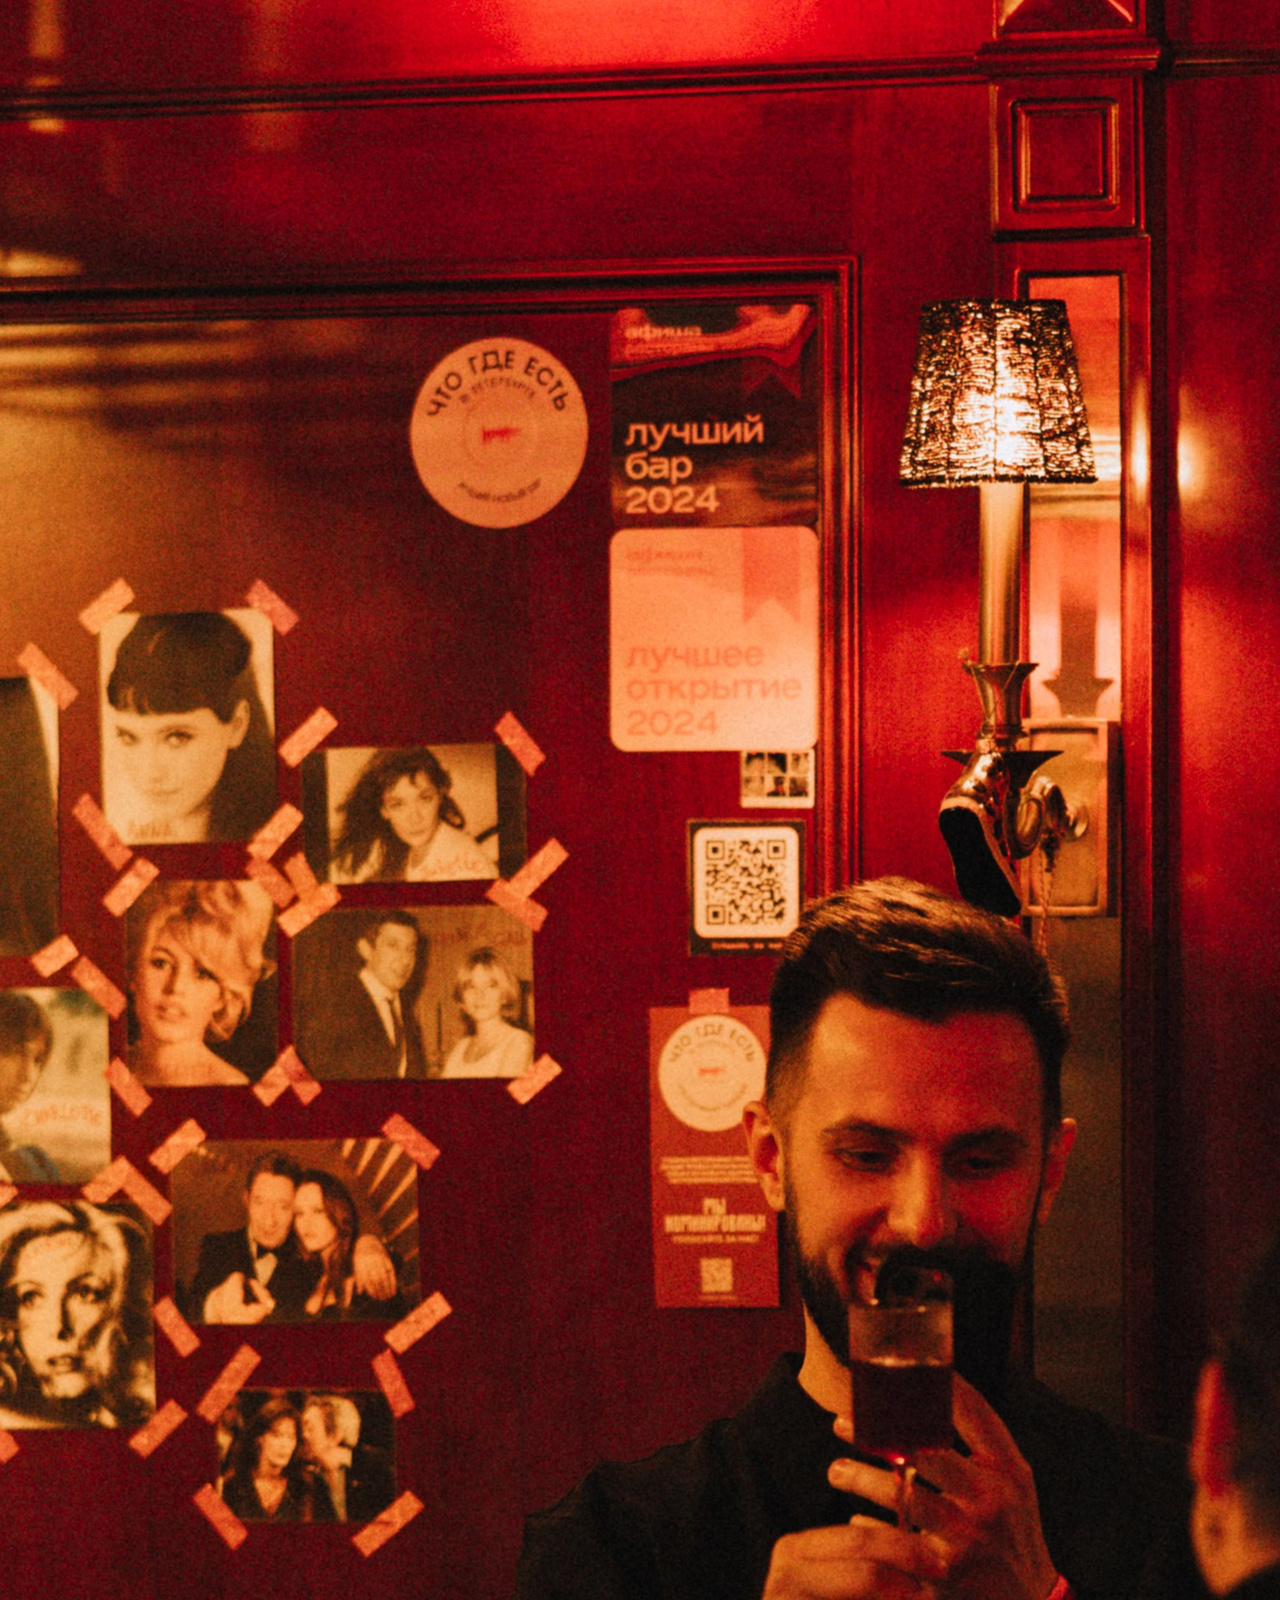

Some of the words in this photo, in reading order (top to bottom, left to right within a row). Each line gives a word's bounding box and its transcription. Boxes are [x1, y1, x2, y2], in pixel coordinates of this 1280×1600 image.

[426, 372, 462, 416] ЧТО
[468, 350, 515, 375] ГДЕ
[524, 357, 569, 412] ЕСТЬ
[624, 413, 765, 452] лучший
[624, 451, 694, 485] бар
[624, 483, 720, 514] 2024
[627, 645, 766, 673] лучшее
[626, 677, 802, 705] открытие
[627, 709, 719, 736] 2024
